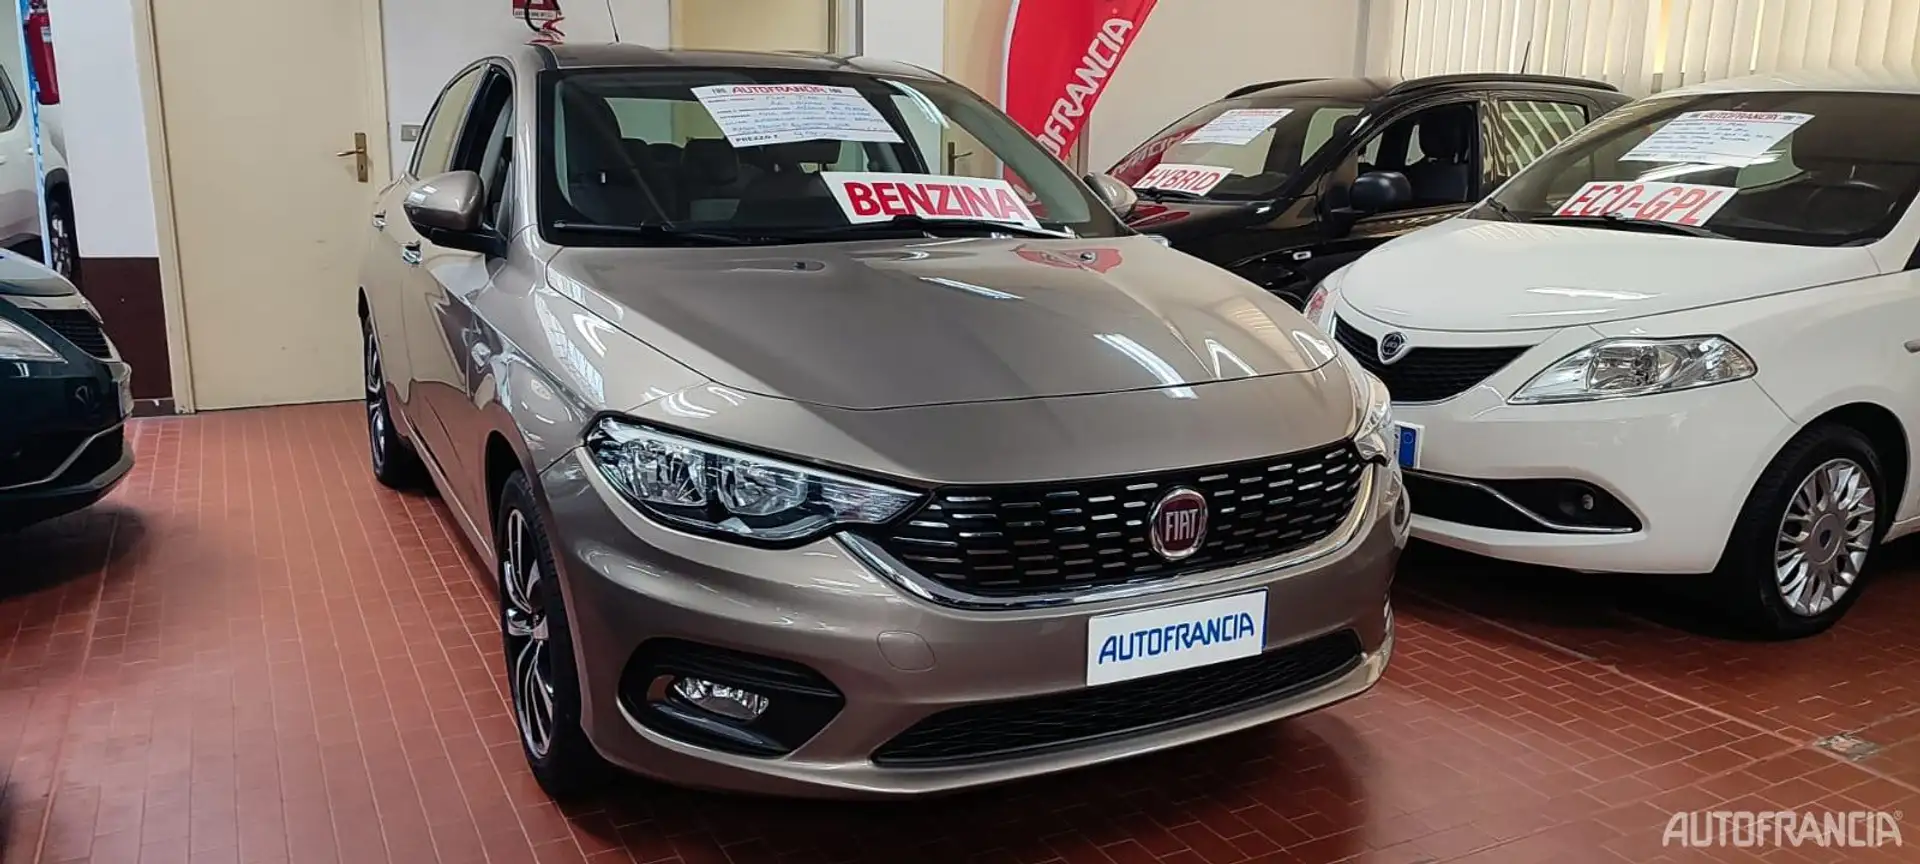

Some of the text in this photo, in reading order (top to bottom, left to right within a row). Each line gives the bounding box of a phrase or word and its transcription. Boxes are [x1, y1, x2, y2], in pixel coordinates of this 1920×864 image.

[1137, 168, 1220, 191] HYBRID
[843, 182, 1030, 220] BENZINA
[1560, 184, 1721, 223] ECO-GPL
[1165, 508, 1199, 541] FIAT
[1099, 612, 1254, 664] AUTOFRANCIA
